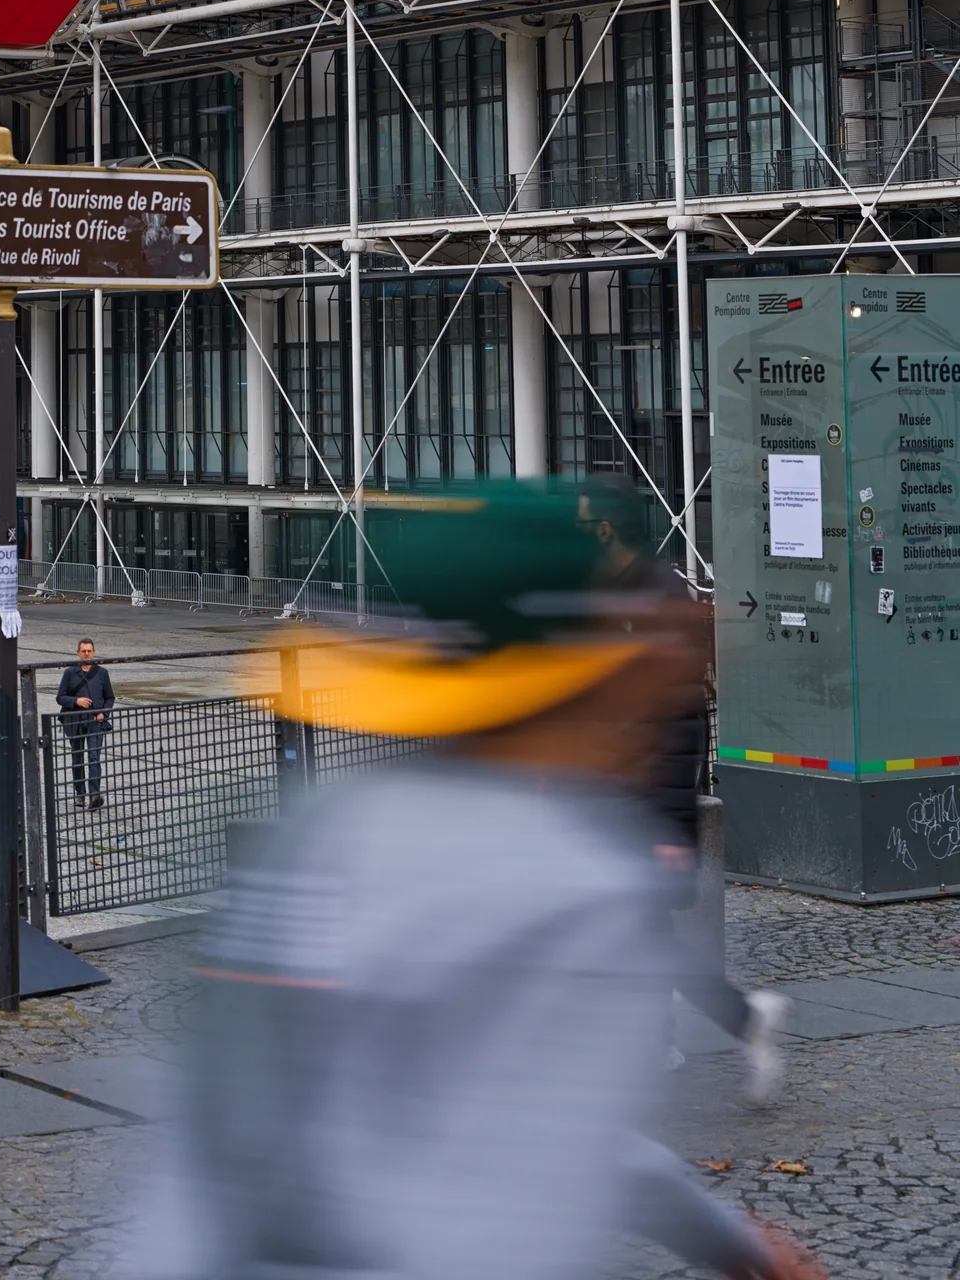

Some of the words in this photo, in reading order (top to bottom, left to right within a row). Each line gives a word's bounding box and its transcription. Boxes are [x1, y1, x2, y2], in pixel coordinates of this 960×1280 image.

[22, 187, 43, 208] de
[48, 187, 123, 210] Tourisme
[127, 191, 147, 211] de
[150, 191, 192, 212] Paris
[13, 217, 71, 239] Tourist
[75, 219, 127, 240] Office
[21, 248, 38, 265] de
[41, 248, 81, 266] Rivoli
[726, 292, 750, 303] Centre
[863, 288, 887, 298] Centre
[714, 306, 751, 318] Pompidou
[759, 357, 825, 383] Entrée
[898, 356, 960, 382] Entrée
[760, 388, 783, 396] Entrance
[787, 388, 807, 396] Entrada
[898, 387, 921, 395] Entrance
[925, 387, 945, 395] Entrada
[760, 414, 792, 426] Musée
[899, 413, 931, 426] Musée
[761, 436, 816, 451] Expositions
[900, 459, 941, 472] Cinémas
[901, 482, 952, 497] Spectacles
[901, 500, 936, 513] vivants
[902, 523, 942, 536] Activités
[764, 562, 788, 570] publique
[765, 592, 782, 600] Entrée
[784, 593, 806, 602] visiteurs
[774, 603, 797, 613] situation
[806, 605, 831, 615] handicap
[766, 613, 776, 621] Rue
